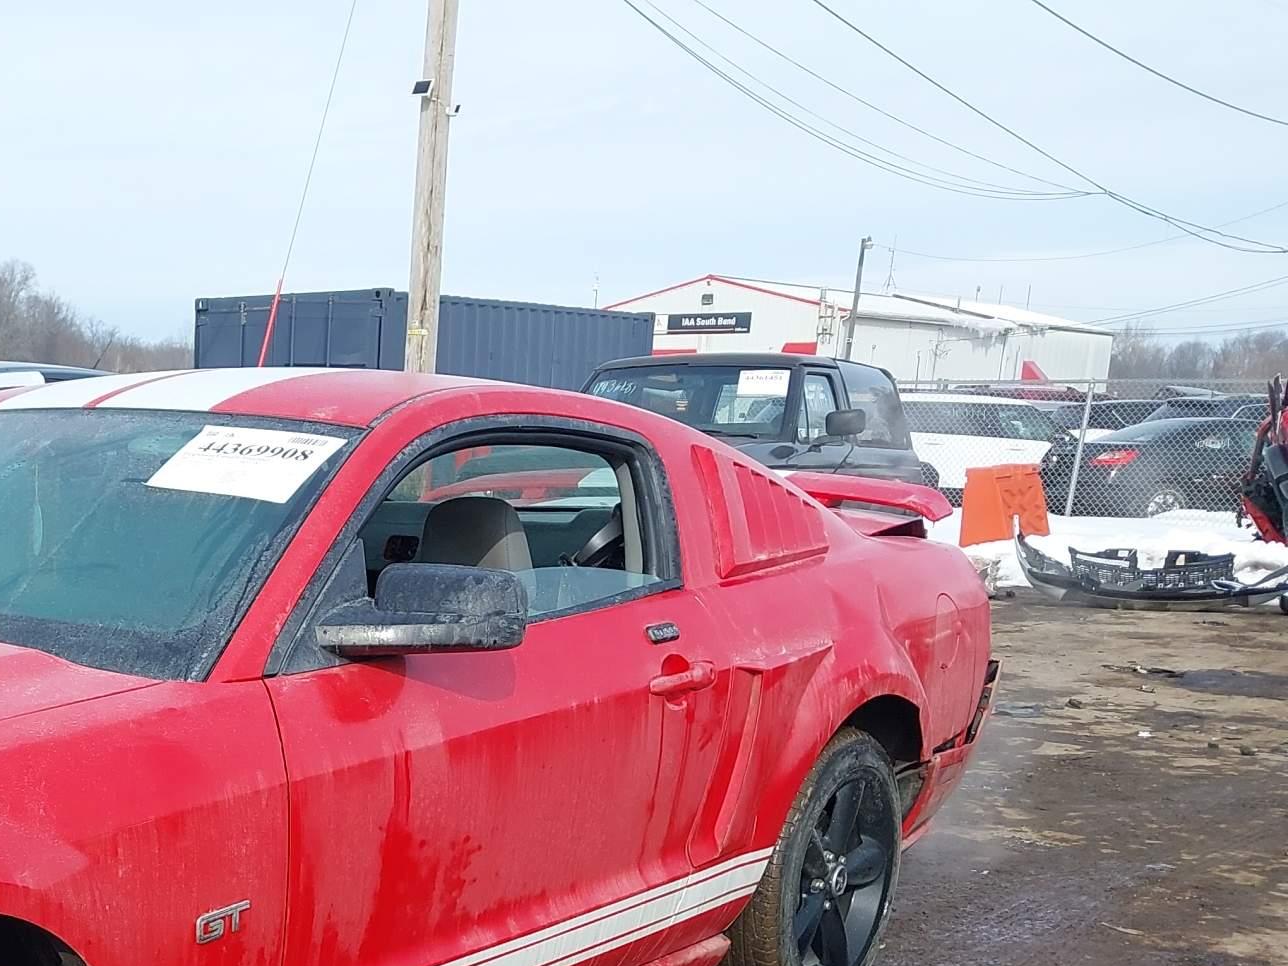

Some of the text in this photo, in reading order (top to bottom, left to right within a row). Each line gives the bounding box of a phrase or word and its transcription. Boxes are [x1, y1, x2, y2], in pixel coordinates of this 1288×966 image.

[681, 317, 695, 326] IAA
[696, 316, 716, 326] South
[198, 441, 314, 462] 44369908
[196, 899, 250, 943] GT
